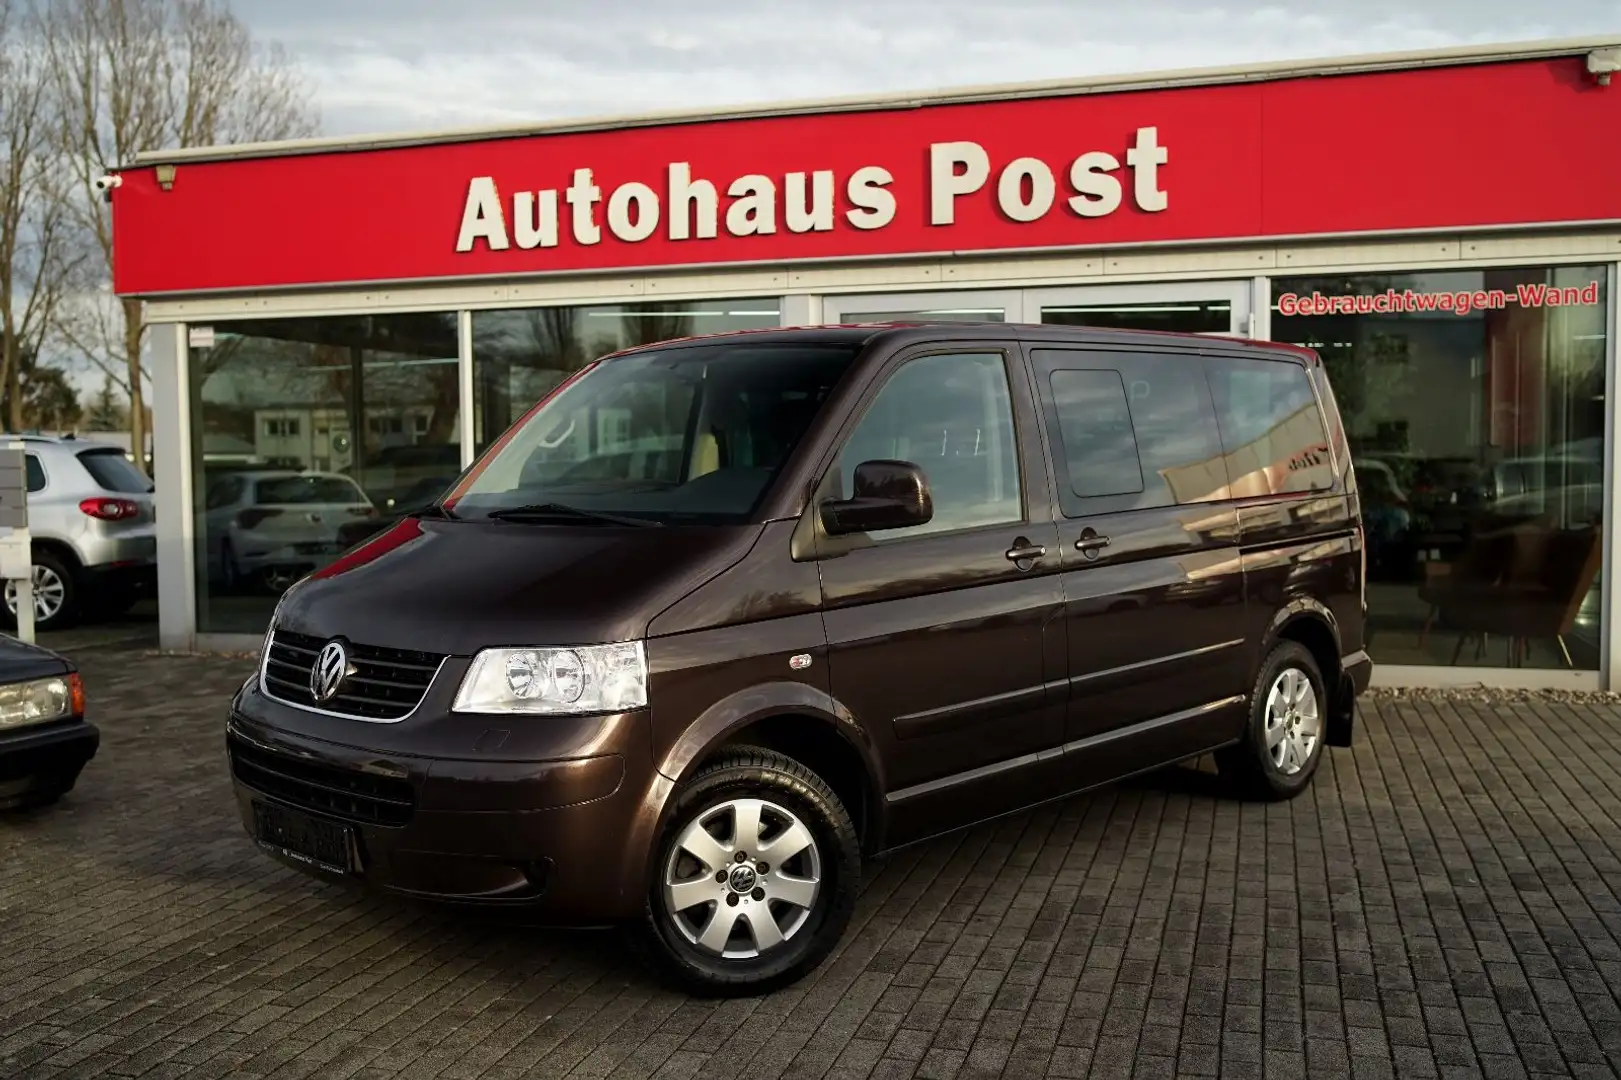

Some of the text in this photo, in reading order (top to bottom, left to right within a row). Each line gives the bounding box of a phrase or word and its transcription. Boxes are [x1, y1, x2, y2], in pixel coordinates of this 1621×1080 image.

[456, 127, 1168, 252] Autohaus Post
[1278, 282, 1598, 316] Gebrauchtwagen-Wand
